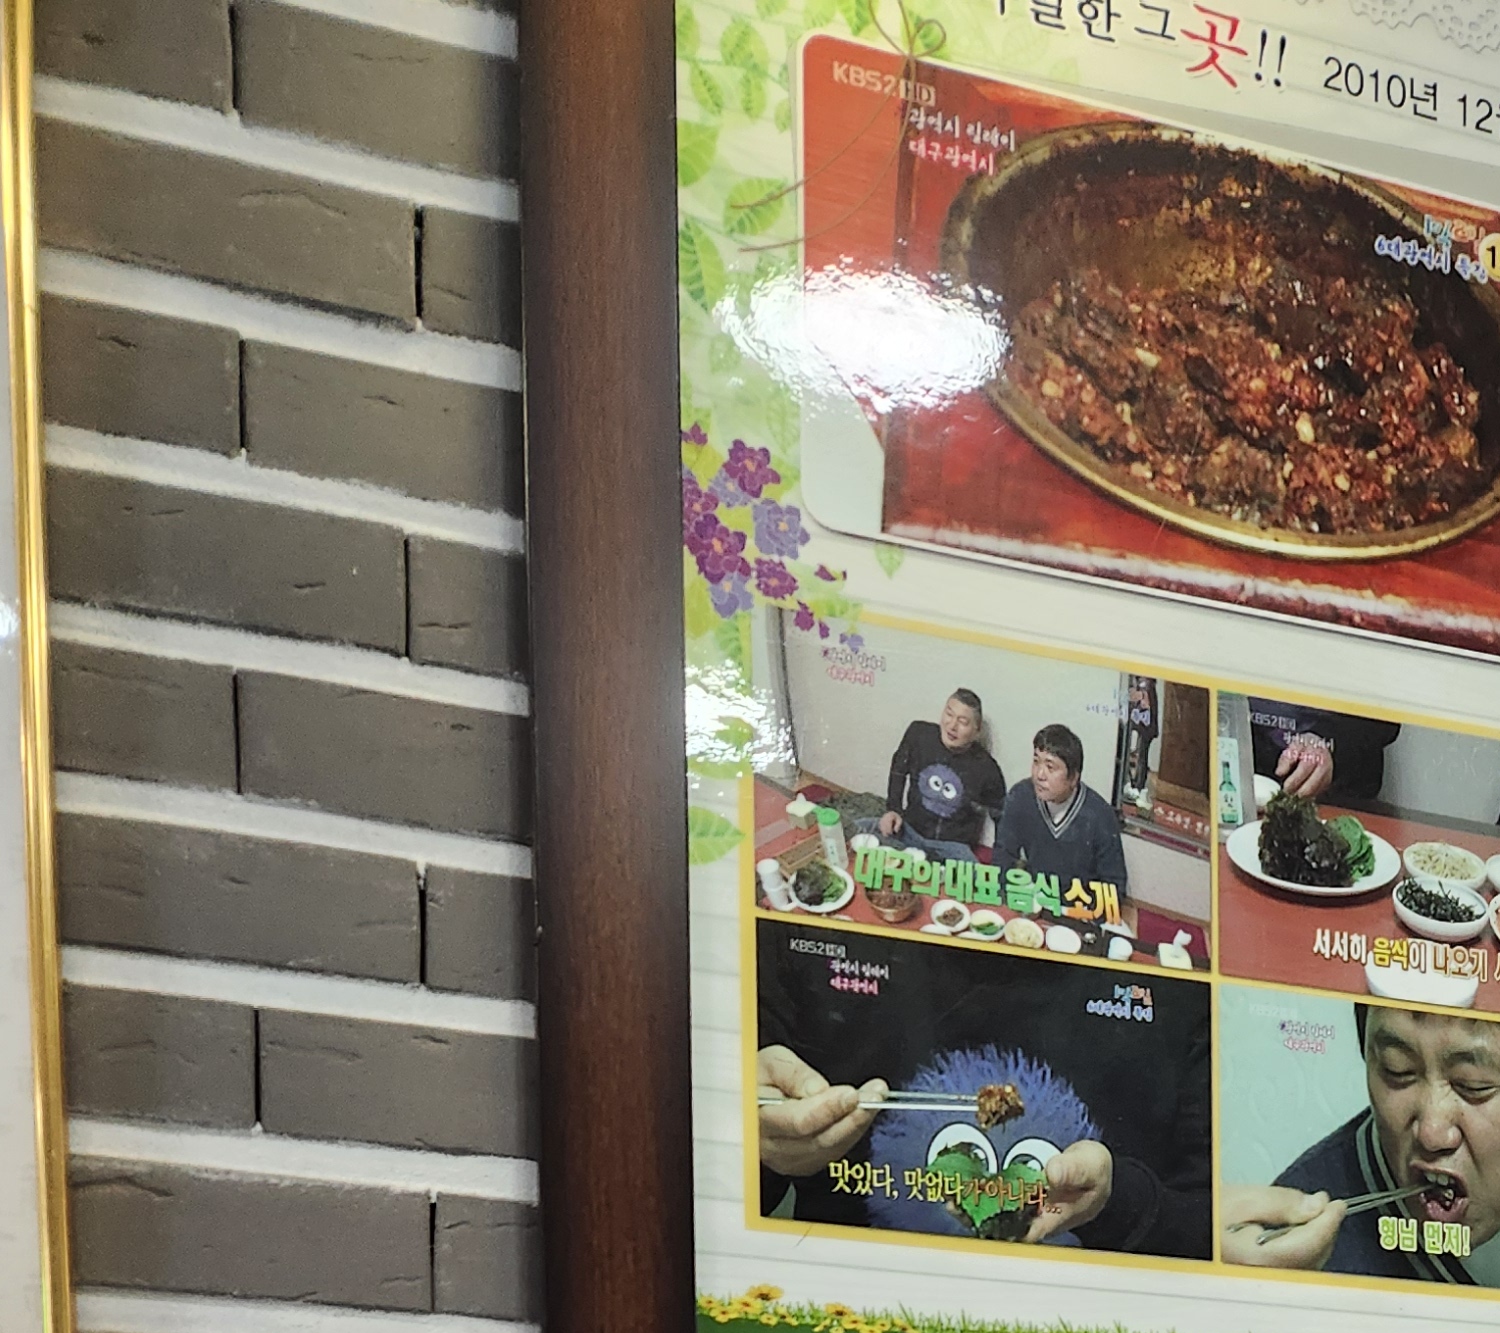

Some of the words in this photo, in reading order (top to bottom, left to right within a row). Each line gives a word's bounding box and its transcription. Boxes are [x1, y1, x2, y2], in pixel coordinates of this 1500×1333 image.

[1323, 55, 1438, 122] 2010년
[853, 844, 942, 899] 대구의
[942, 857, 1004, 906] 대표
[1003, 867, 1061, 918] 음식
[1061, 879, 1123, 927] 소개
[1372, 937, 1428, 971] 음식이
[1432, 944, 1489, 983] 나오기
[1378, 1215, 1418, 1252] 형님
[1422, 1220, 1472, 1257] 먼저!
